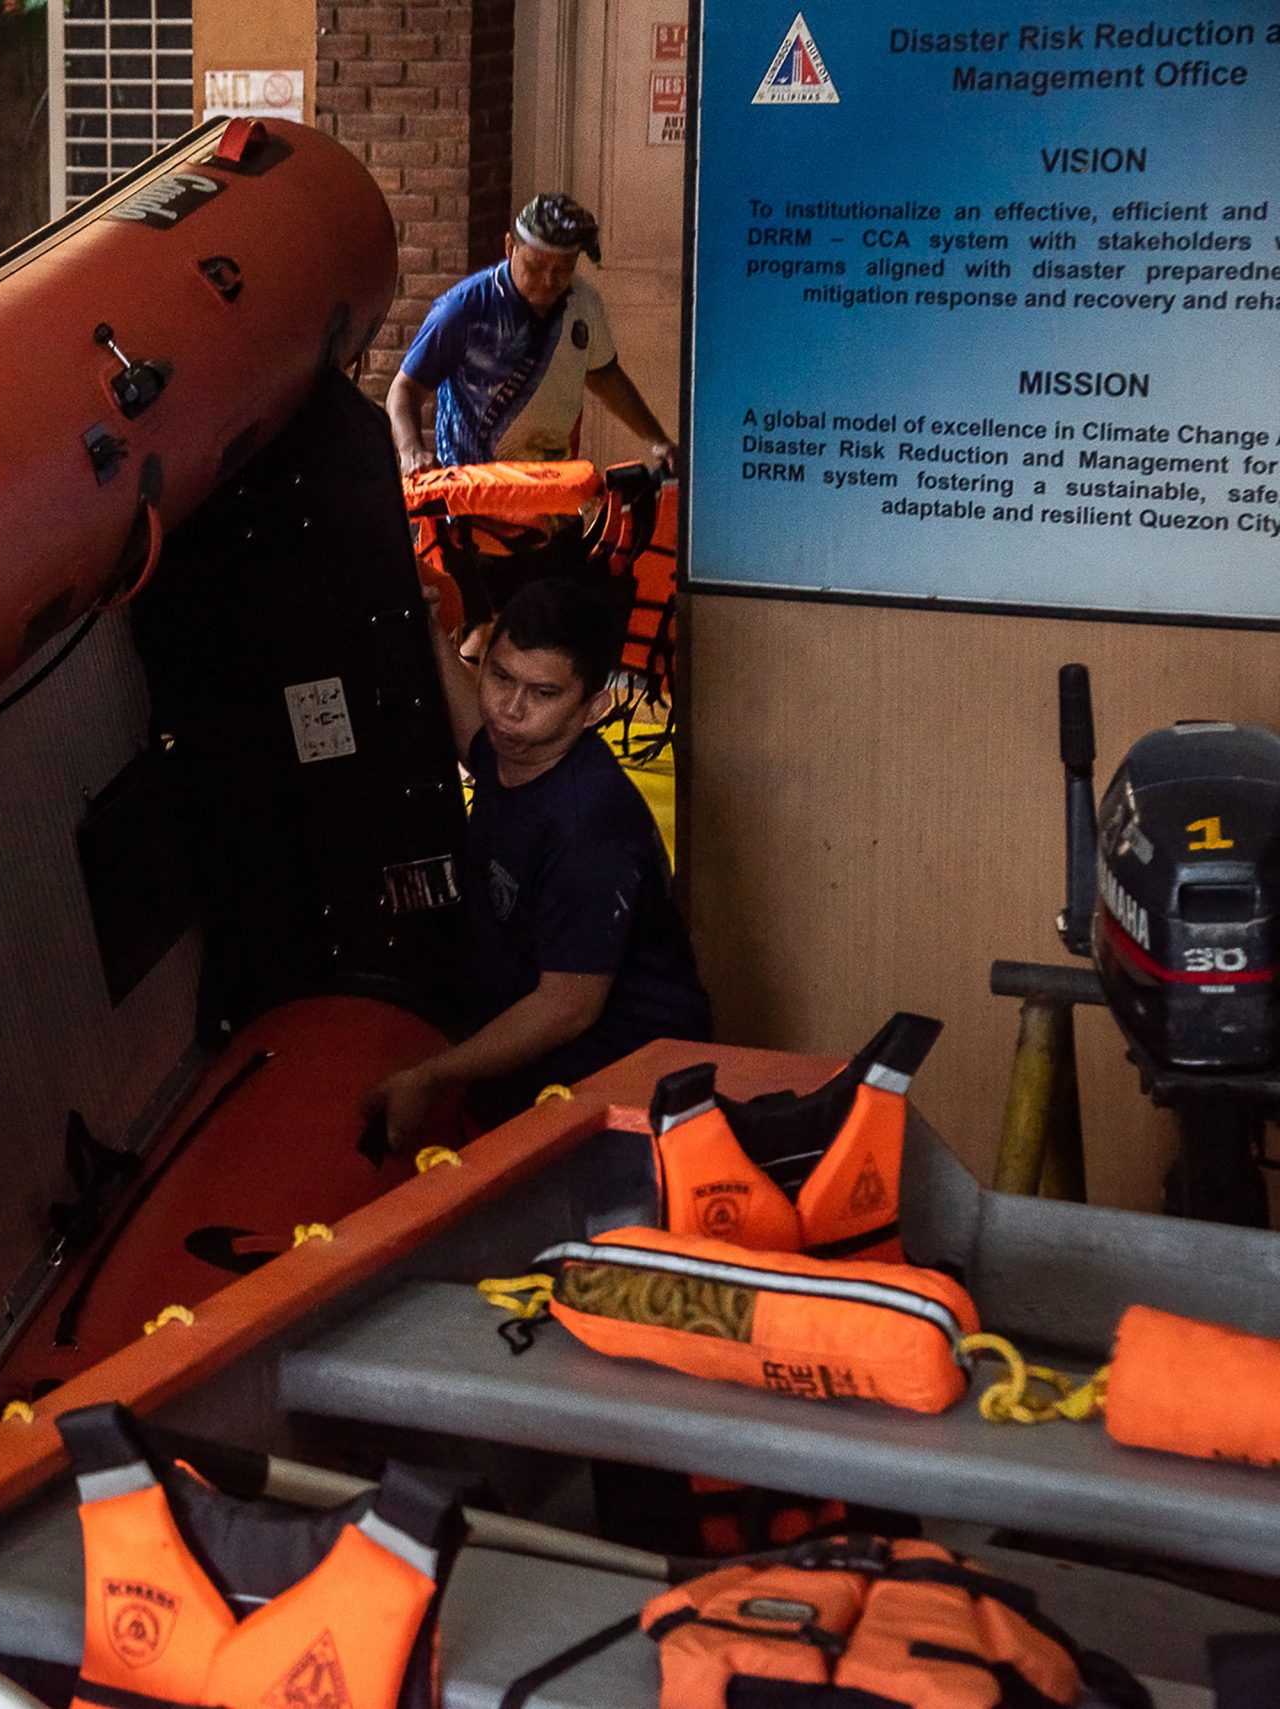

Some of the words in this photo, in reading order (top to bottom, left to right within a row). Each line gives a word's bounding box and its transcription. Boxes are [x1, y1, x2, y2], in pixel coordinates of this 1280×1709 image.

[889, 28, 1010, 53] Disaster
[1020, 24, 1084, 50] Risk
[1094, 21, 1254, 48] Reduction
[952, 62, 1145, 96] Management
[1155, 60, 1248, 86] Office
[1041, 147, 1147, 174] VISION
[750, 200, 773, 219] To
[785, 200, 941, 221] institutionalize
[954, 204, 980, 220] an
[995, 201, 1097, 225] effective,
[1112, 201, 1208, 221] efficient
[1222, 201, 1268, 221] and
[748, 228, 812, 247] DRRM
[862, 230, 910, 248] CCA
[929, 231, 1008, 254] system
[1030, 231, 1076, 250] with
[1098, 231, 1252, 251] stakeholders
[747, 258, 846, 279] programs
[866, 257, 945, 281] aligned
[965, 258, 1012, 278] with
[1032, 260, 1126, 280] disaster
[803, 284, 908, 308] mitigation
[915, 290, 1017, 310] response
[1024, 289, 1066, 308] and
[1073, 292, 1176, 315] recovery
[1182, 290, 1228, 310] and
[1019, 370, 1150, 398] MISSION
[742, 408, 757, 427] A
[763, 410, 826, 431] global
[833, 413, 896, 433] model
[903, 416, 926, 434] of
[930, 418, 1047, 440] excellence
[1054, 421, 1074, 440] in
[1082, 422, 1170, 443] Climate
[1177, 424, 1269, 450] Change
[743, 435, 827, 456] Disaster
[839, 439, 885, 460] Risk
[899, 442, 1008, 466] Reduction
[1022, 449, 1064, 468] and
[1078, 450, 1228, 476] Management
[1243, 455, 1278, 475] for
[742, 462, 805, 482] DRRM
[823, 469, 897, 489] system
[917, 470, 1013, 497] fostering
[1033, 480, 1046, 494] a
[1066, 480, 1206, 504] sustainable,
[882, 497, 986, 520] adaptable
[993, 503, 1033, 523] and
[1041, 505, 1133, 527] resilient
[1139, 508, 1229, 532] Quezon
[1186, 816, 1234, 850] 1
[1183, 947, 1248, 972] 30
